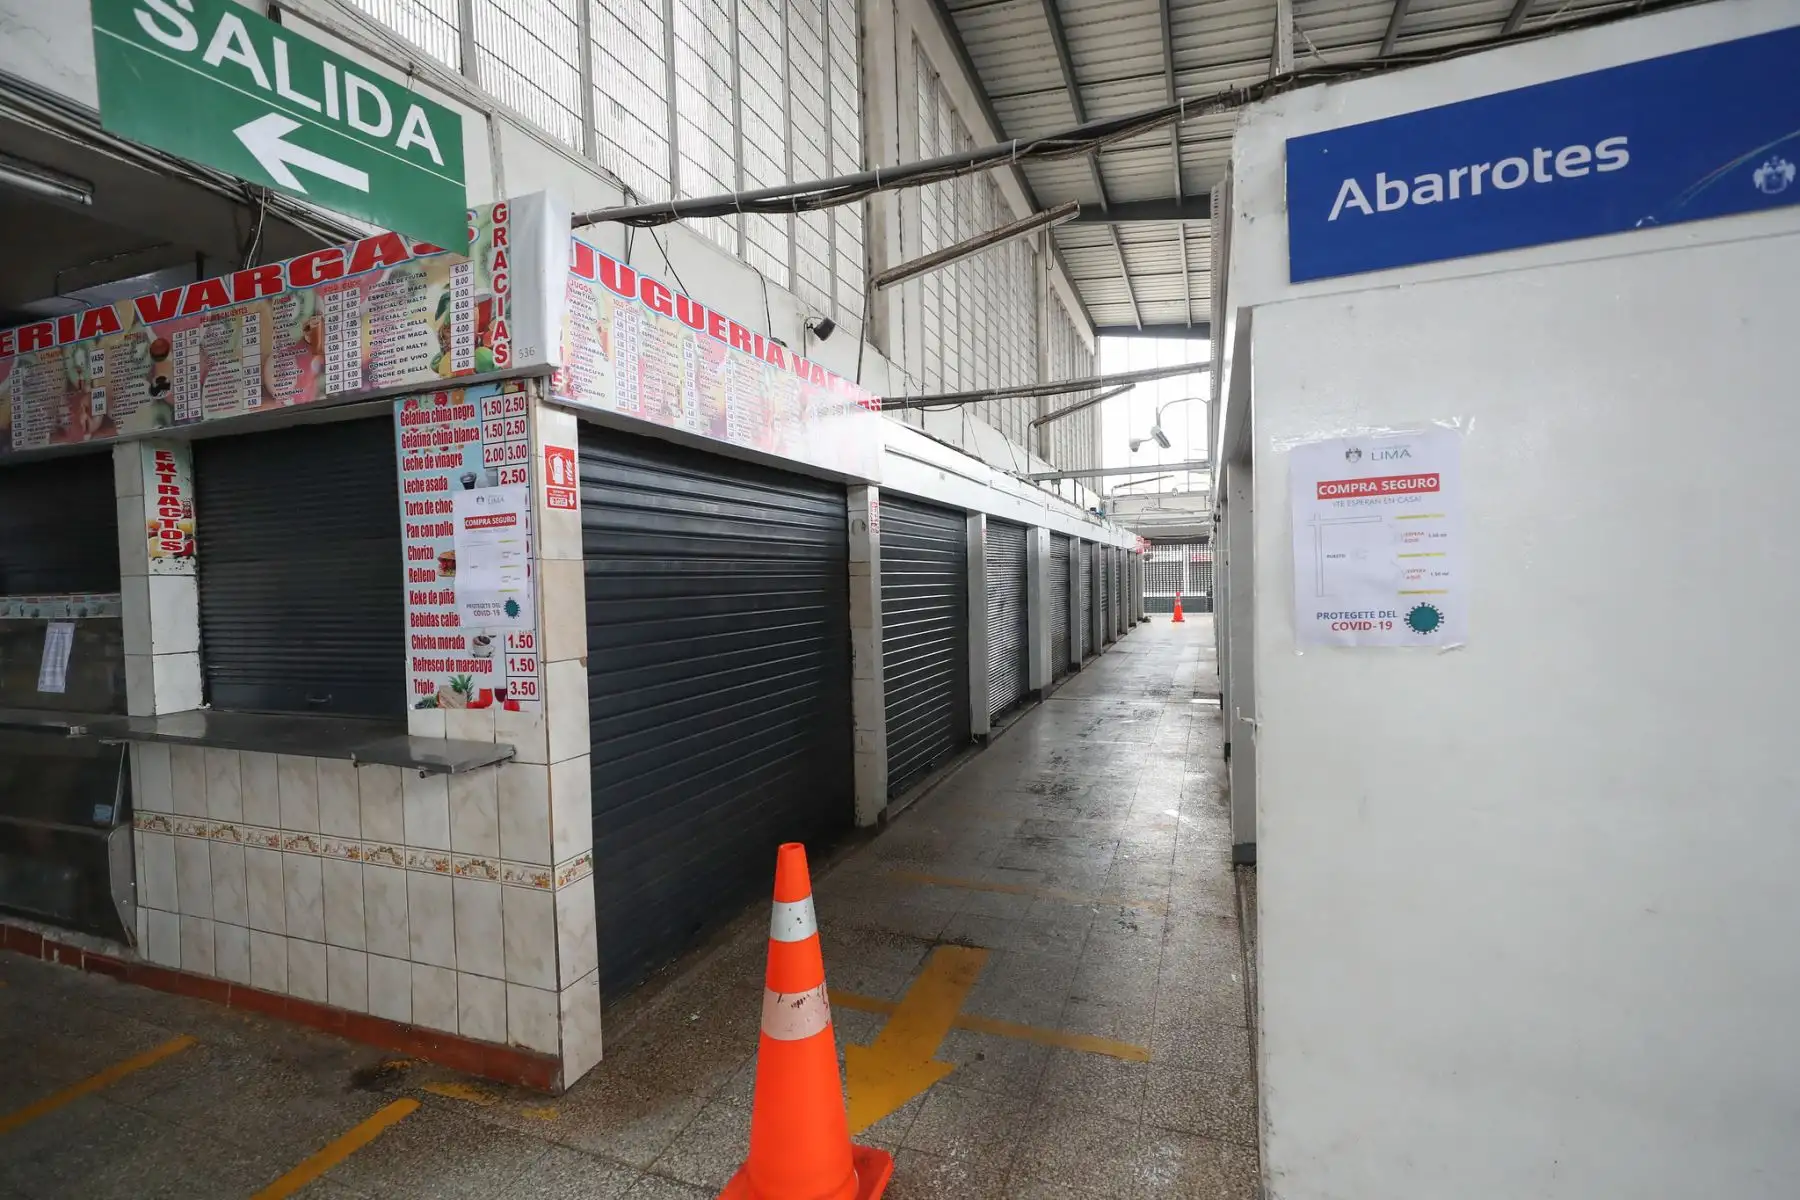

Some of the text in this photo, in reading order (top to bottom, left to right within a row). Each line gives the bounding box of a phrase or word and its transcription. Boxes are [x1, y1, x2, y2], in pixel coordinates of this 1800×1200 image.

[133, 0, 445, 166] SALIDA
[1327, 136, 1630, 222] Abarrotes
[135, 213, 477, 324] VARGA
[455, 276, 469, 286] 8.00
[492, 203, 508, 365] GRACIAS
[455, 300, 469, 309] 8.00
[569, 241, 786, 370] JUGUERIA
[455, 312, 469, 321] 8.00
[456, 324, 469, 333] 4.00
[456, 336, 470, 345] 4.00
[456, 348, 470, 356] 4.00
[456, 359, 470, 368] 4.00
[483, 396, 524, 415] 1.50 2.50
[401, 404, 475, 427] Gelatina china negra
[484, 420, 525, 439] 1.50 2.50
[402, 427, 480, 449] Gelatina china blanca
[485, 444, 527, 463] 2.00 3.00
[1371, 448, 1412, 461] LIMA
[403, 452, 463, 472] Leche de vinagre
[500, 468, 526, 485] 2.50
[404, 476, 448, 494] Leche asada
[1319, 477, 1438, 496] COMPRA SEGURO
[155, 450, 183, 552] EXTRACTOS
[405, 500, 423, 516] Torta
[425, 500, 434, 515] de
[1347, 498, 1382, 507] ESPERAN
[1384, 496, 1394, 504] EN
[465, 515, 516, 528] COMPRA SEGURO
[406, 523, 420, 539] Pan
[422, 524, 434, 538] con
[435, 522, 454, 537] pollo
[407, 545, 434, 561] Chorizo
[408, 567, 436, 583] Relleno
[409, 588, 455, 606] Keke de piña
[410, 612, 461, 628] Bebidas calie
[1316, 610, 1398, 621] PROTEGETE DEL
[1331, 620, 1393, 632] COVID-19
[411, 634, 465, 650] Chicha morada
[508, 634, 533, 649] 1.50
[412, 656, 492, 674] Refresco de maracuya
[509, 658, 535, 673] 1.50
[413, 678, 435, 695] Triple
[510, 680, 536, 696] 3.50
